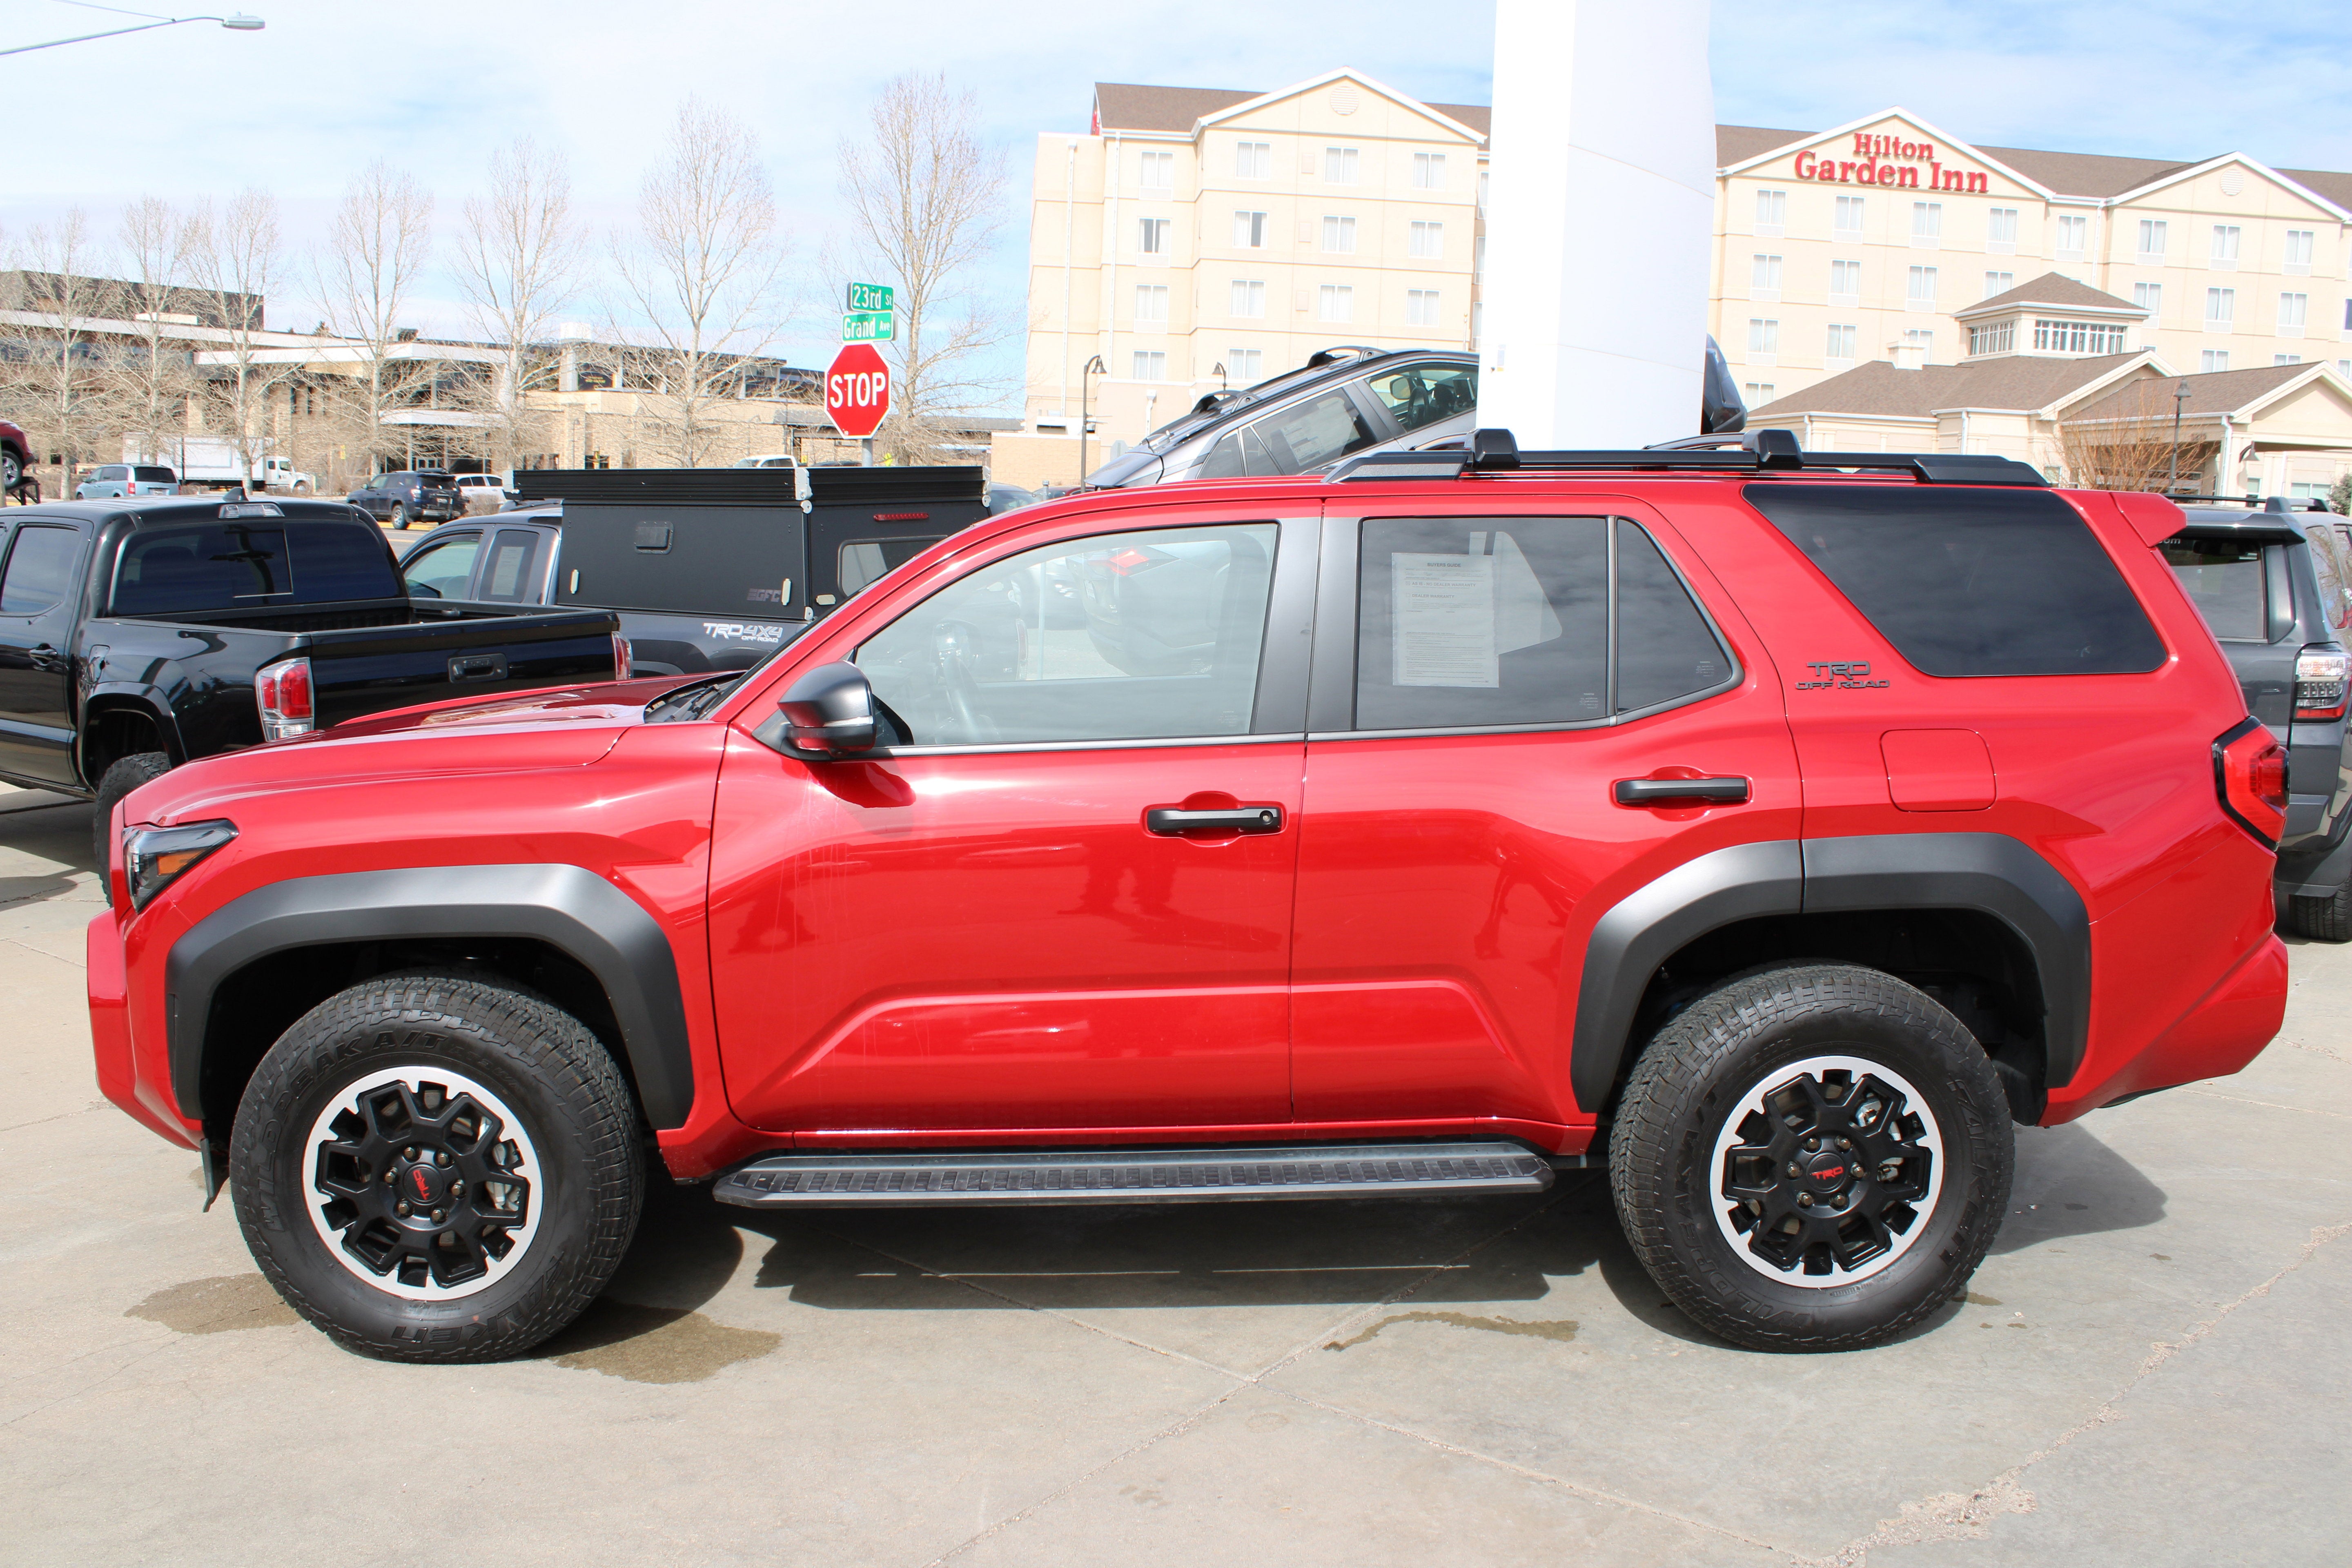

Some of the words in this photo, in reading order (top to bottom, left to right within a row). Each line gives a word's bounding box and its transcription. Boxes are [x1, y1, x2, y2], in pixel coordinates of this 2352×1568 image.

[1853, 133, 1934, 159] Hilton
[1795, 150, 1920, 187] Garden
[1929, 162, 1989, 194] Inn
[853, 285, 882, 310] 23rd
[885, 294, 892, 306] St
[844, 316, 875, 339] Grand
[879, 320, 890, 332] Ave
[830, 372, 886, 408] STOP
[703, 623, 744, 640] TRD
[1806, 661, 1871, 680] TRD
[1795, 681, 1833, 690] OFF
[1837, 679, 1890, 689] ROAD
[259, 1037, 362, 1232] WILDPEAK
[372, 1030, 448, 1050] A/T
[412, 1169, 430, 1200] TRD
[1811, 1166, 1844, 1180] TRD
